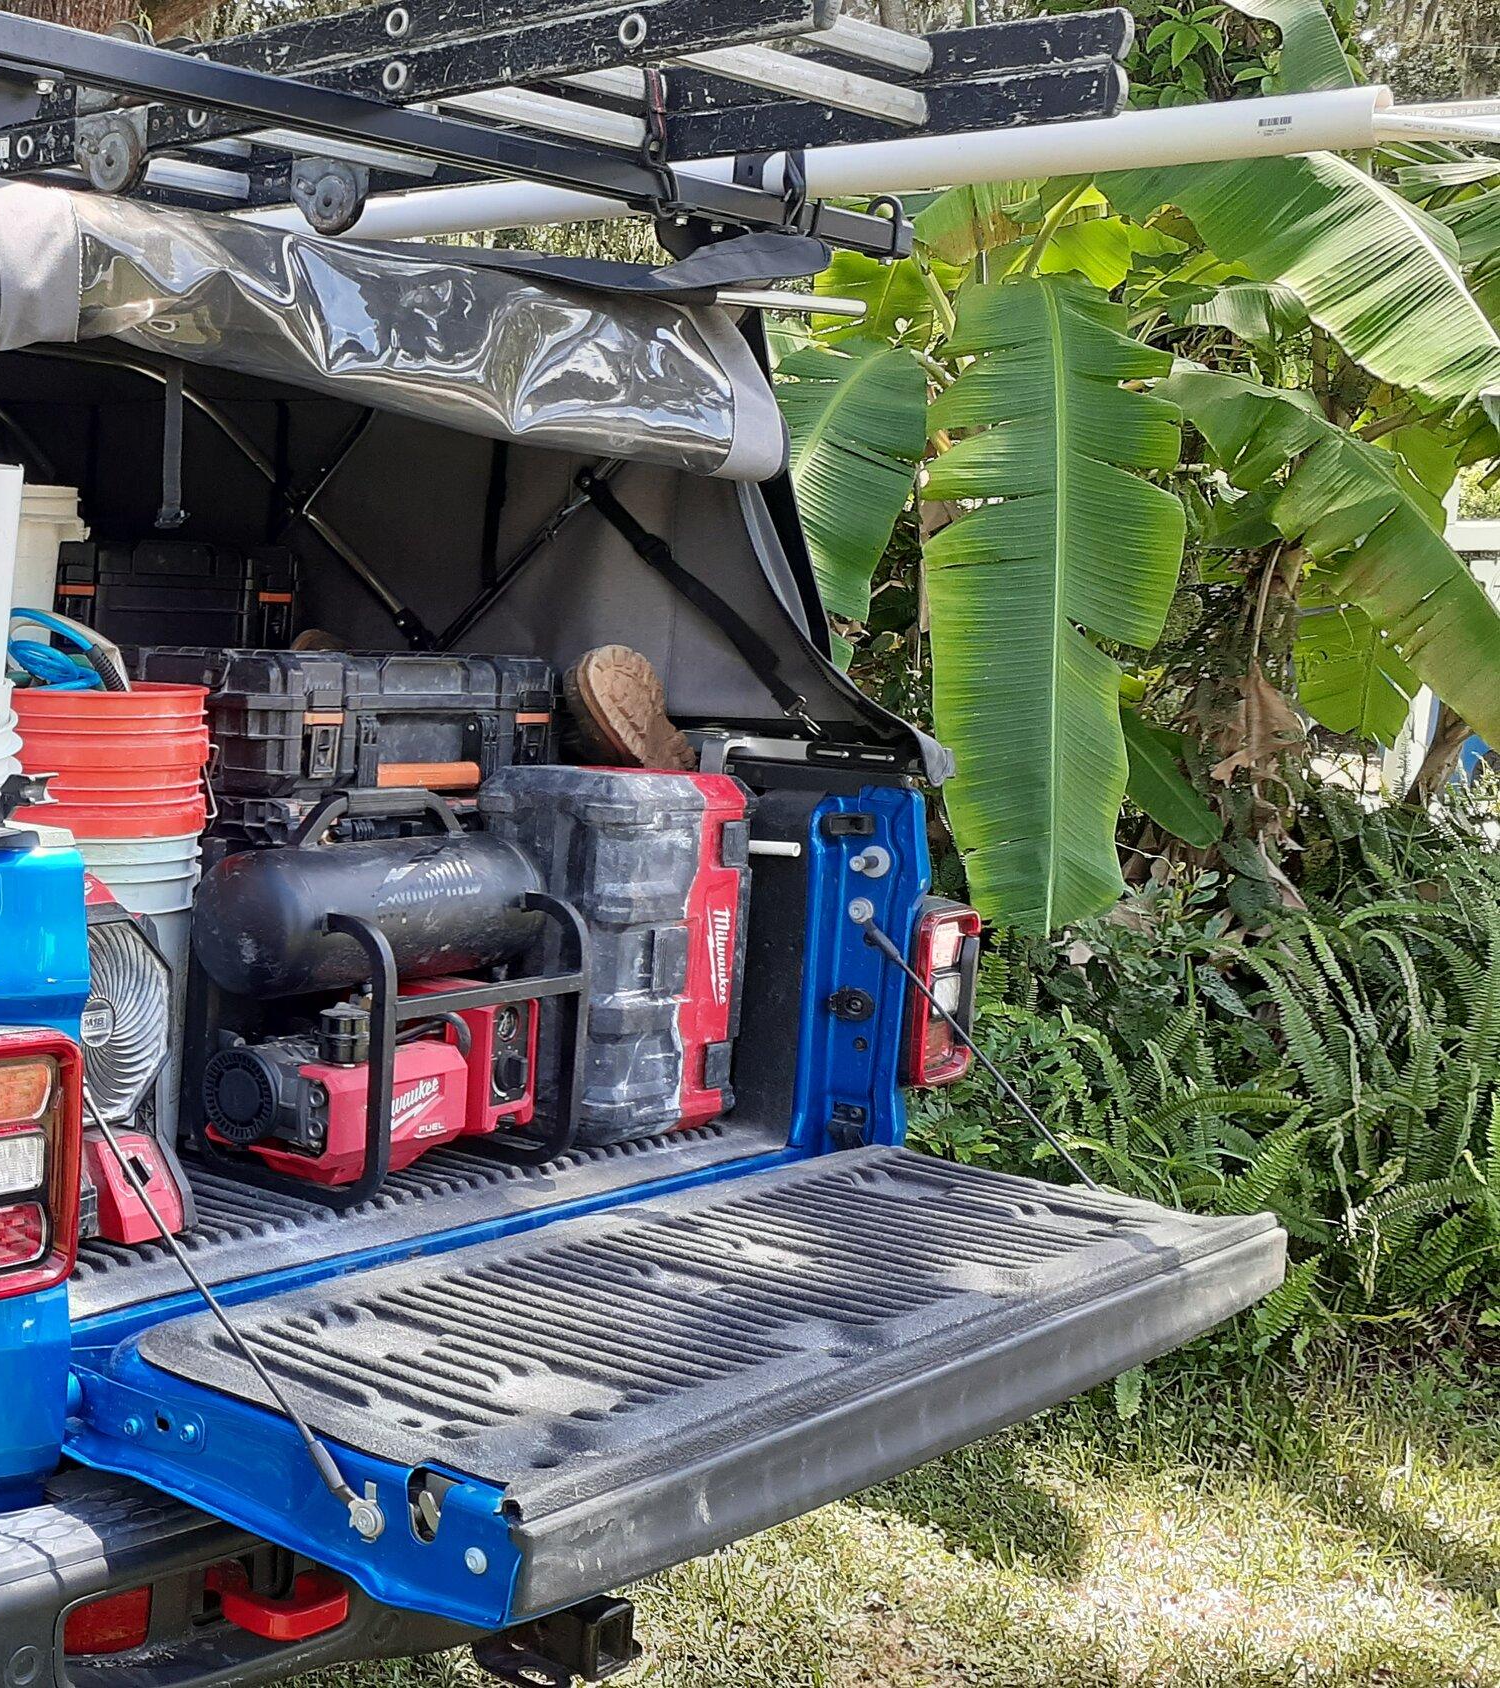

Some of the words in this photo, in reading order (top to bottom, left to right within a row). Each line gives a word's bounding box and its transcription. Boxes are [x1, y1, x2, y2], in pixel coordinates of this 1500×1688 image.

[712, 905, 731, 1006] Milwaukee
[83, 1016, 105, 1029] M18
[391, 1077, 440, 1117] waukee
[418, 1121, 445, 1134] FUEL
